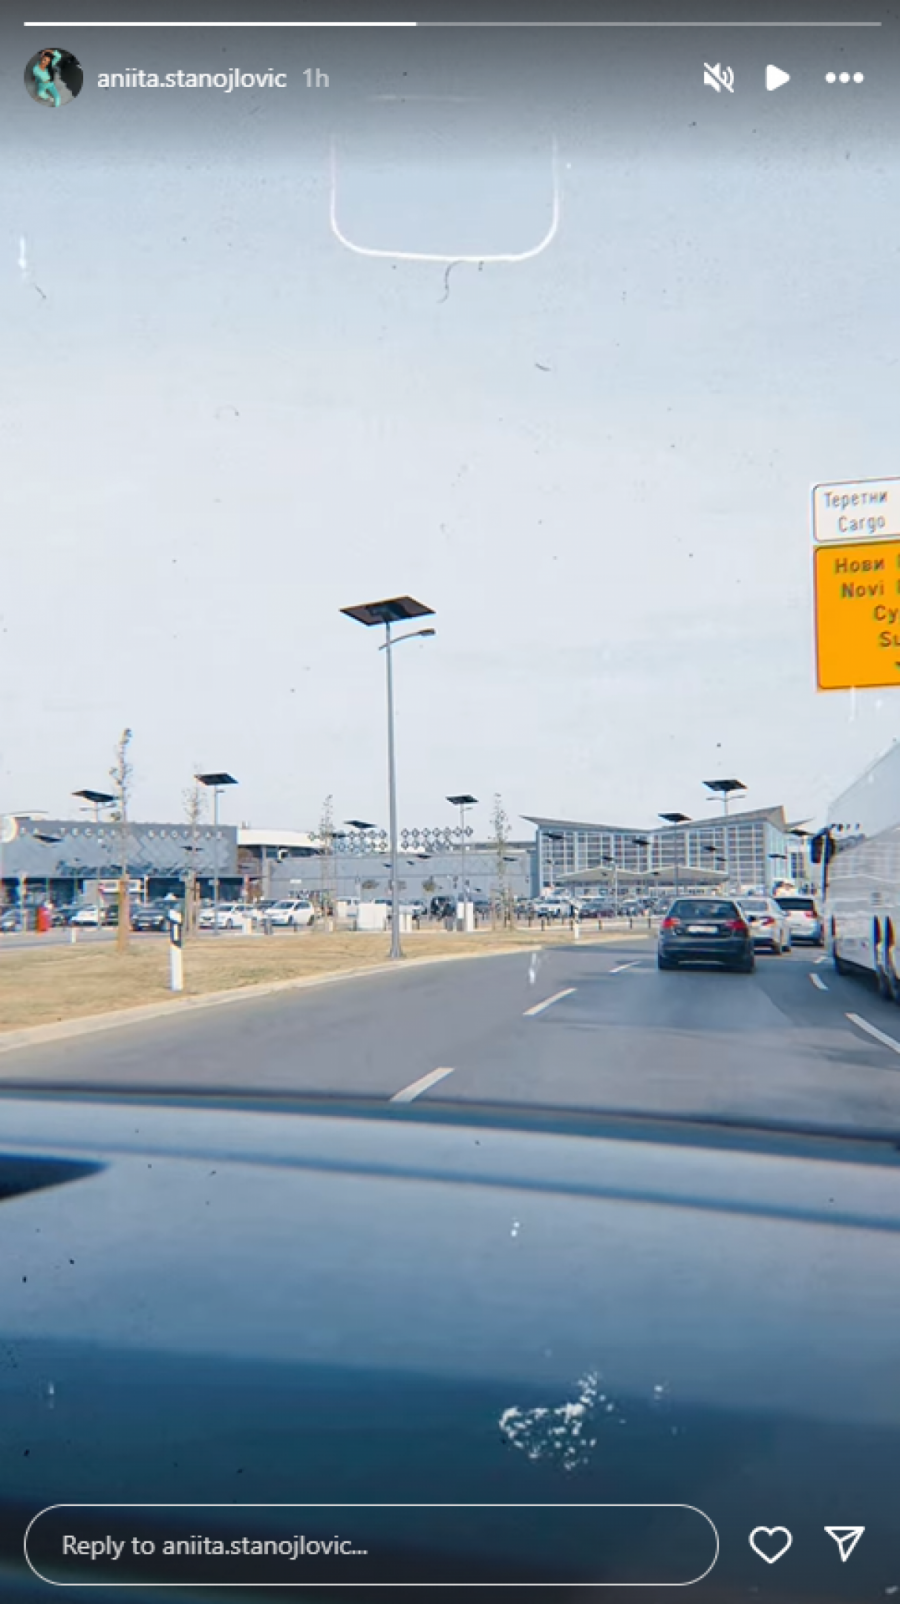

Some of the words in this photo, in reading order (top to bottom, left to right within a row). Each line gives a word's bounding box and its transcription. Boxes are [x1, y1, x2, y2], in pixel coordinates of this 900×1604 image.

[823, 490, 889, 511] Теретни
[837, 515, 887, 535] Cargo
[834, 557, 886, 575] Нови
[841, 580, 885, 598] Novi
